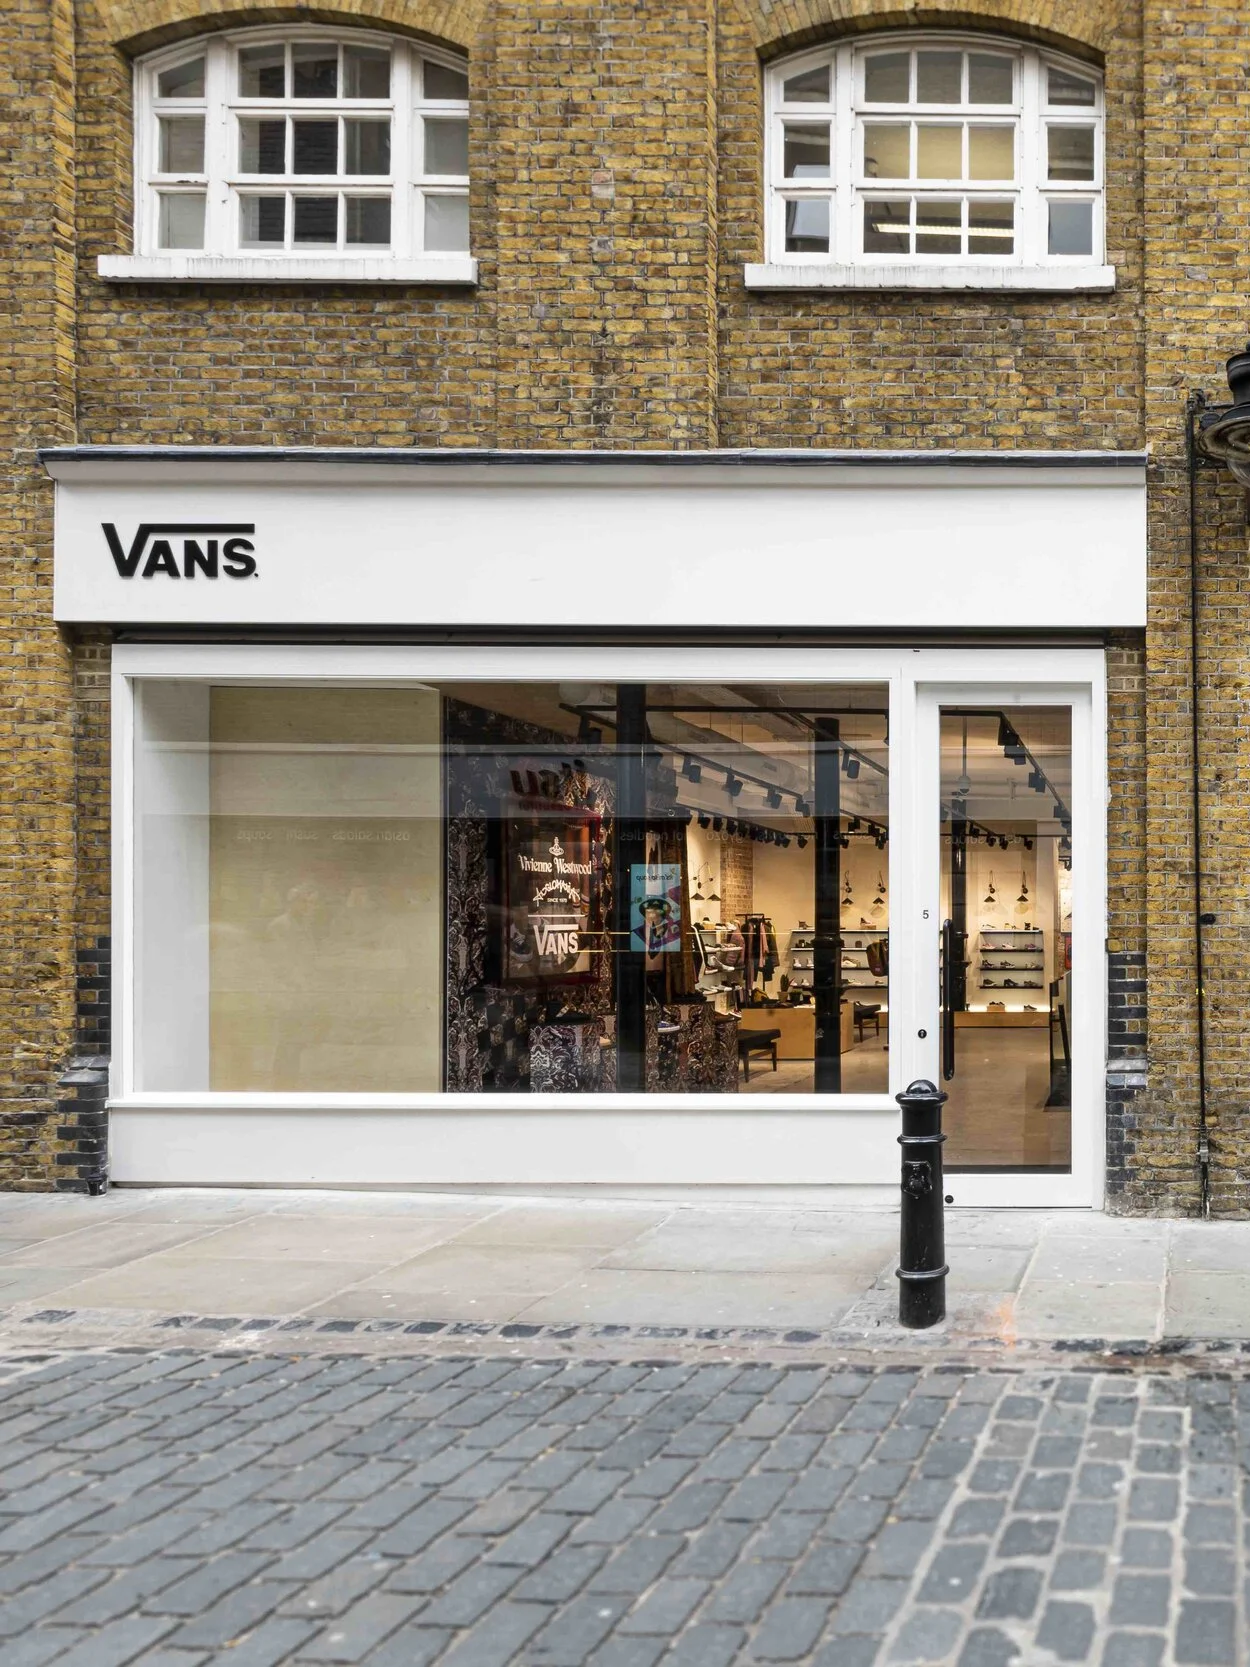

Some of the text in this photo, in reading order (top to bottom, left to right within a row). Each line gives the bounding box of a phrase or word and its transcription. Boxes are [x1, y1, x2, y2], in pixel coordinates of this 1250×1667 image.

[101, 523, 259, 578] VANS
[518, 854, 592, 875] Vivienne Westwood
[922, 909, 929, 920] 5
[533, 924, 579, 955] VANS
